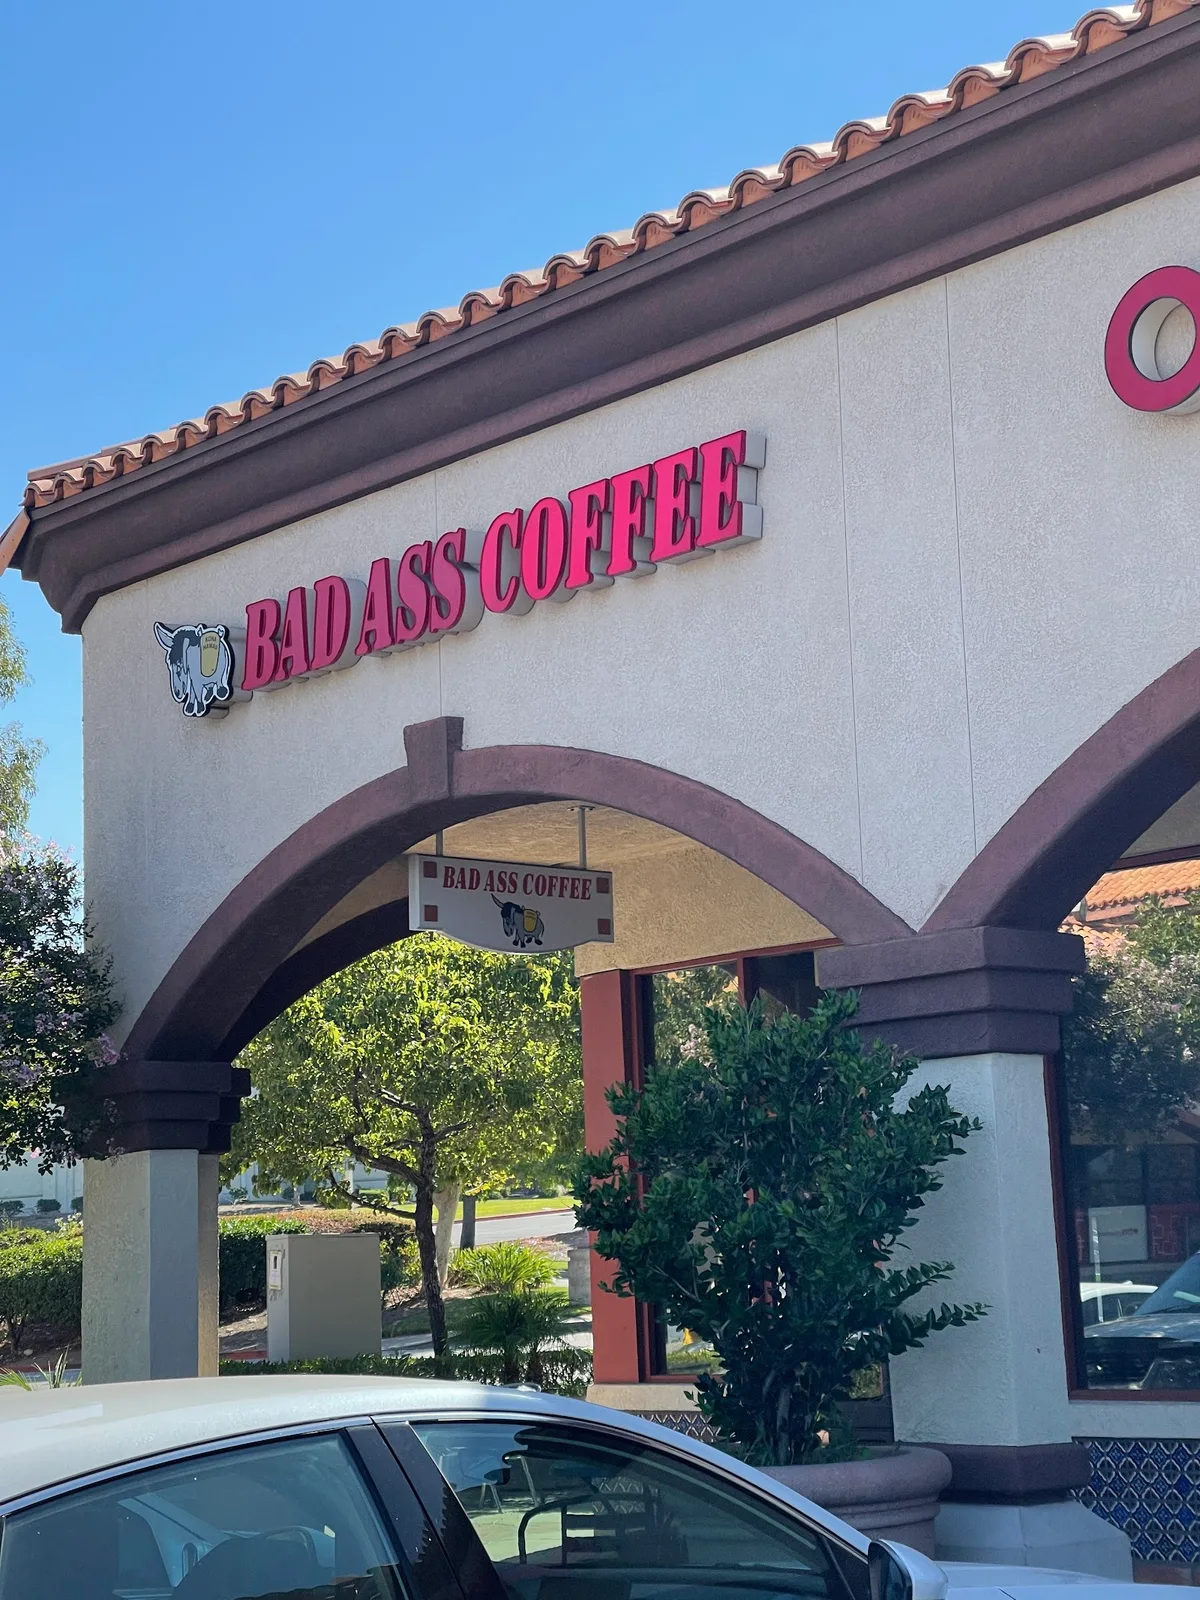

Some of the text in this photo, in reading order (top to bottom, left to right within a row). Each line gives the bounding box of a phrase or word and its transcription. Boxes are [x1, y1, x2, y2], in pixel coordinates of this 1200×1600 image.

[242, 429, 746, 691] BAD ASS COFFEE
[442, 865, 592, 900] BAD ASS COFFEE
